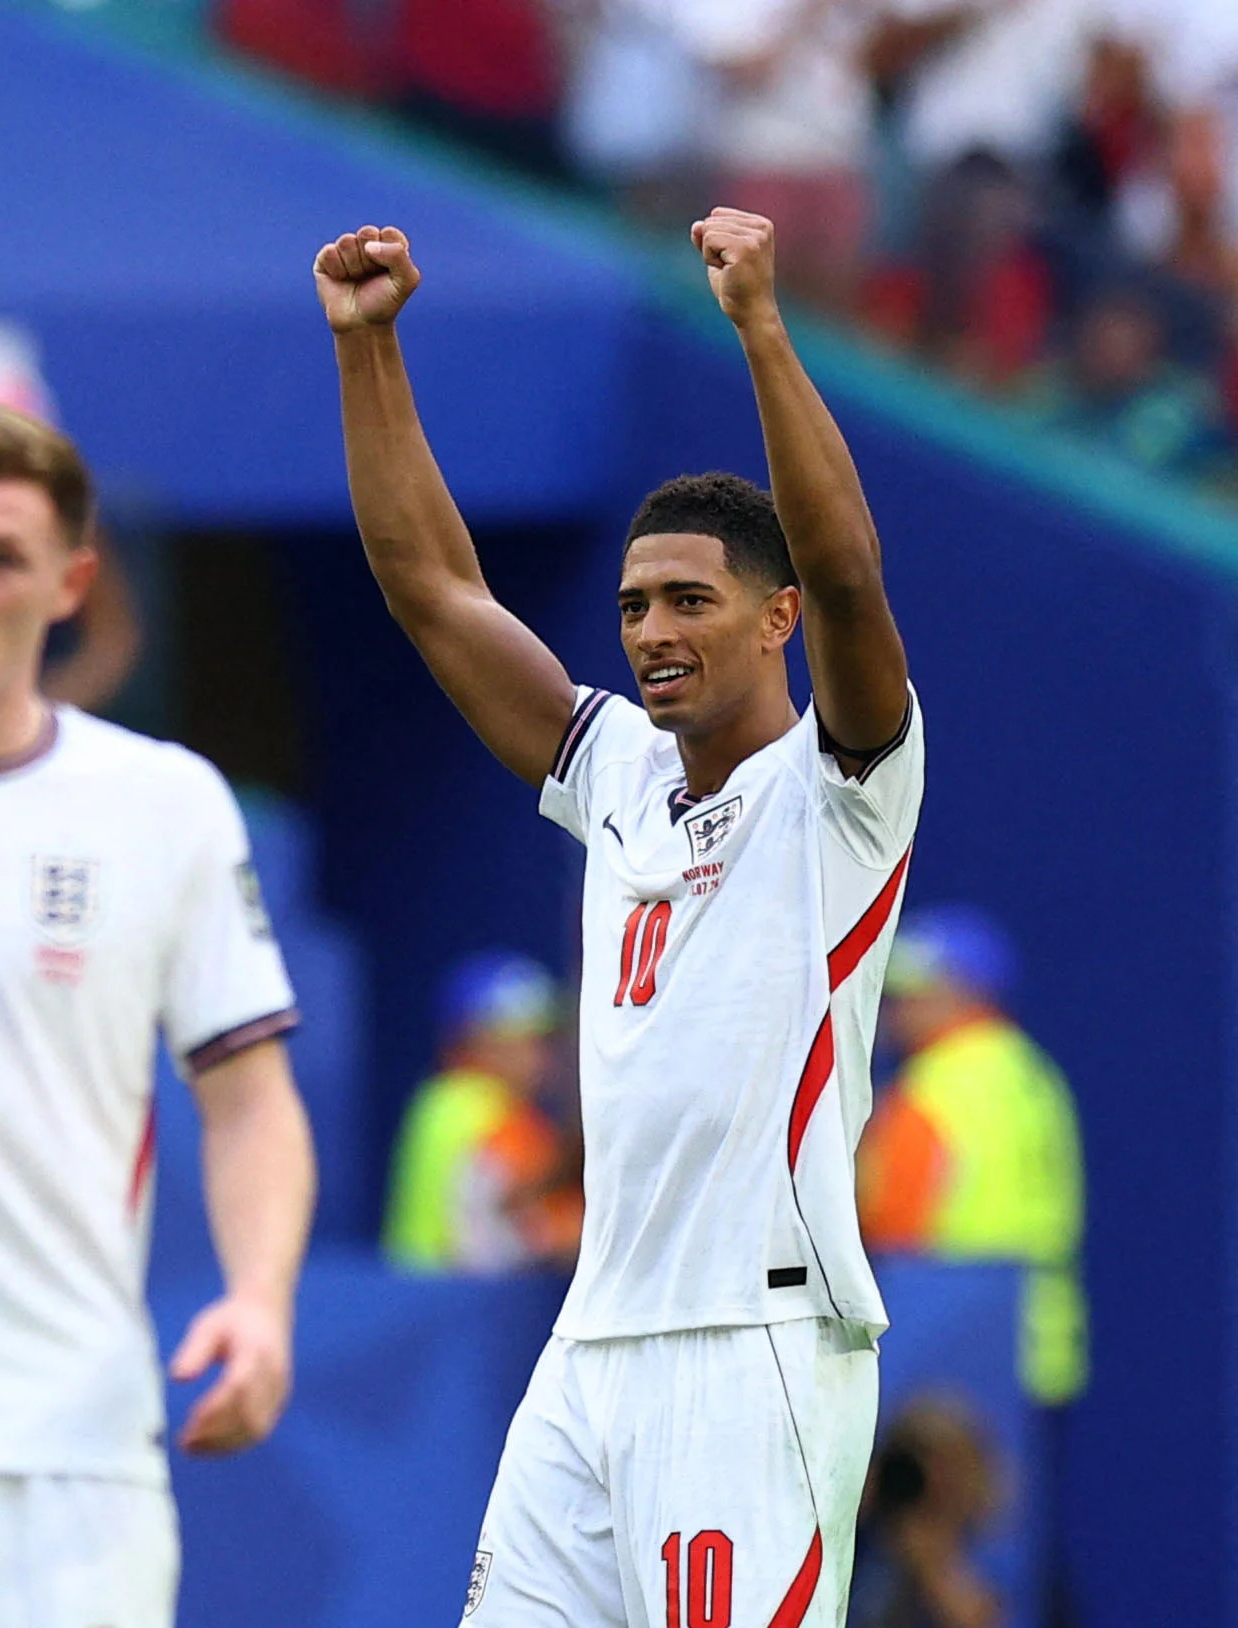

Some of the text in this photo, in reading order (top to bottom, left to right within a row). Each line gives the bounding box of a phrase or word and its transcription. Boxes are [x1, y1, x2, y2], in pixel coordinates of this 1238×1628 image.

[682, 861, 724, 883] NORWAY
[613, 900, 673, 1007] 10
[661, 1529, 733, 1628] 10
